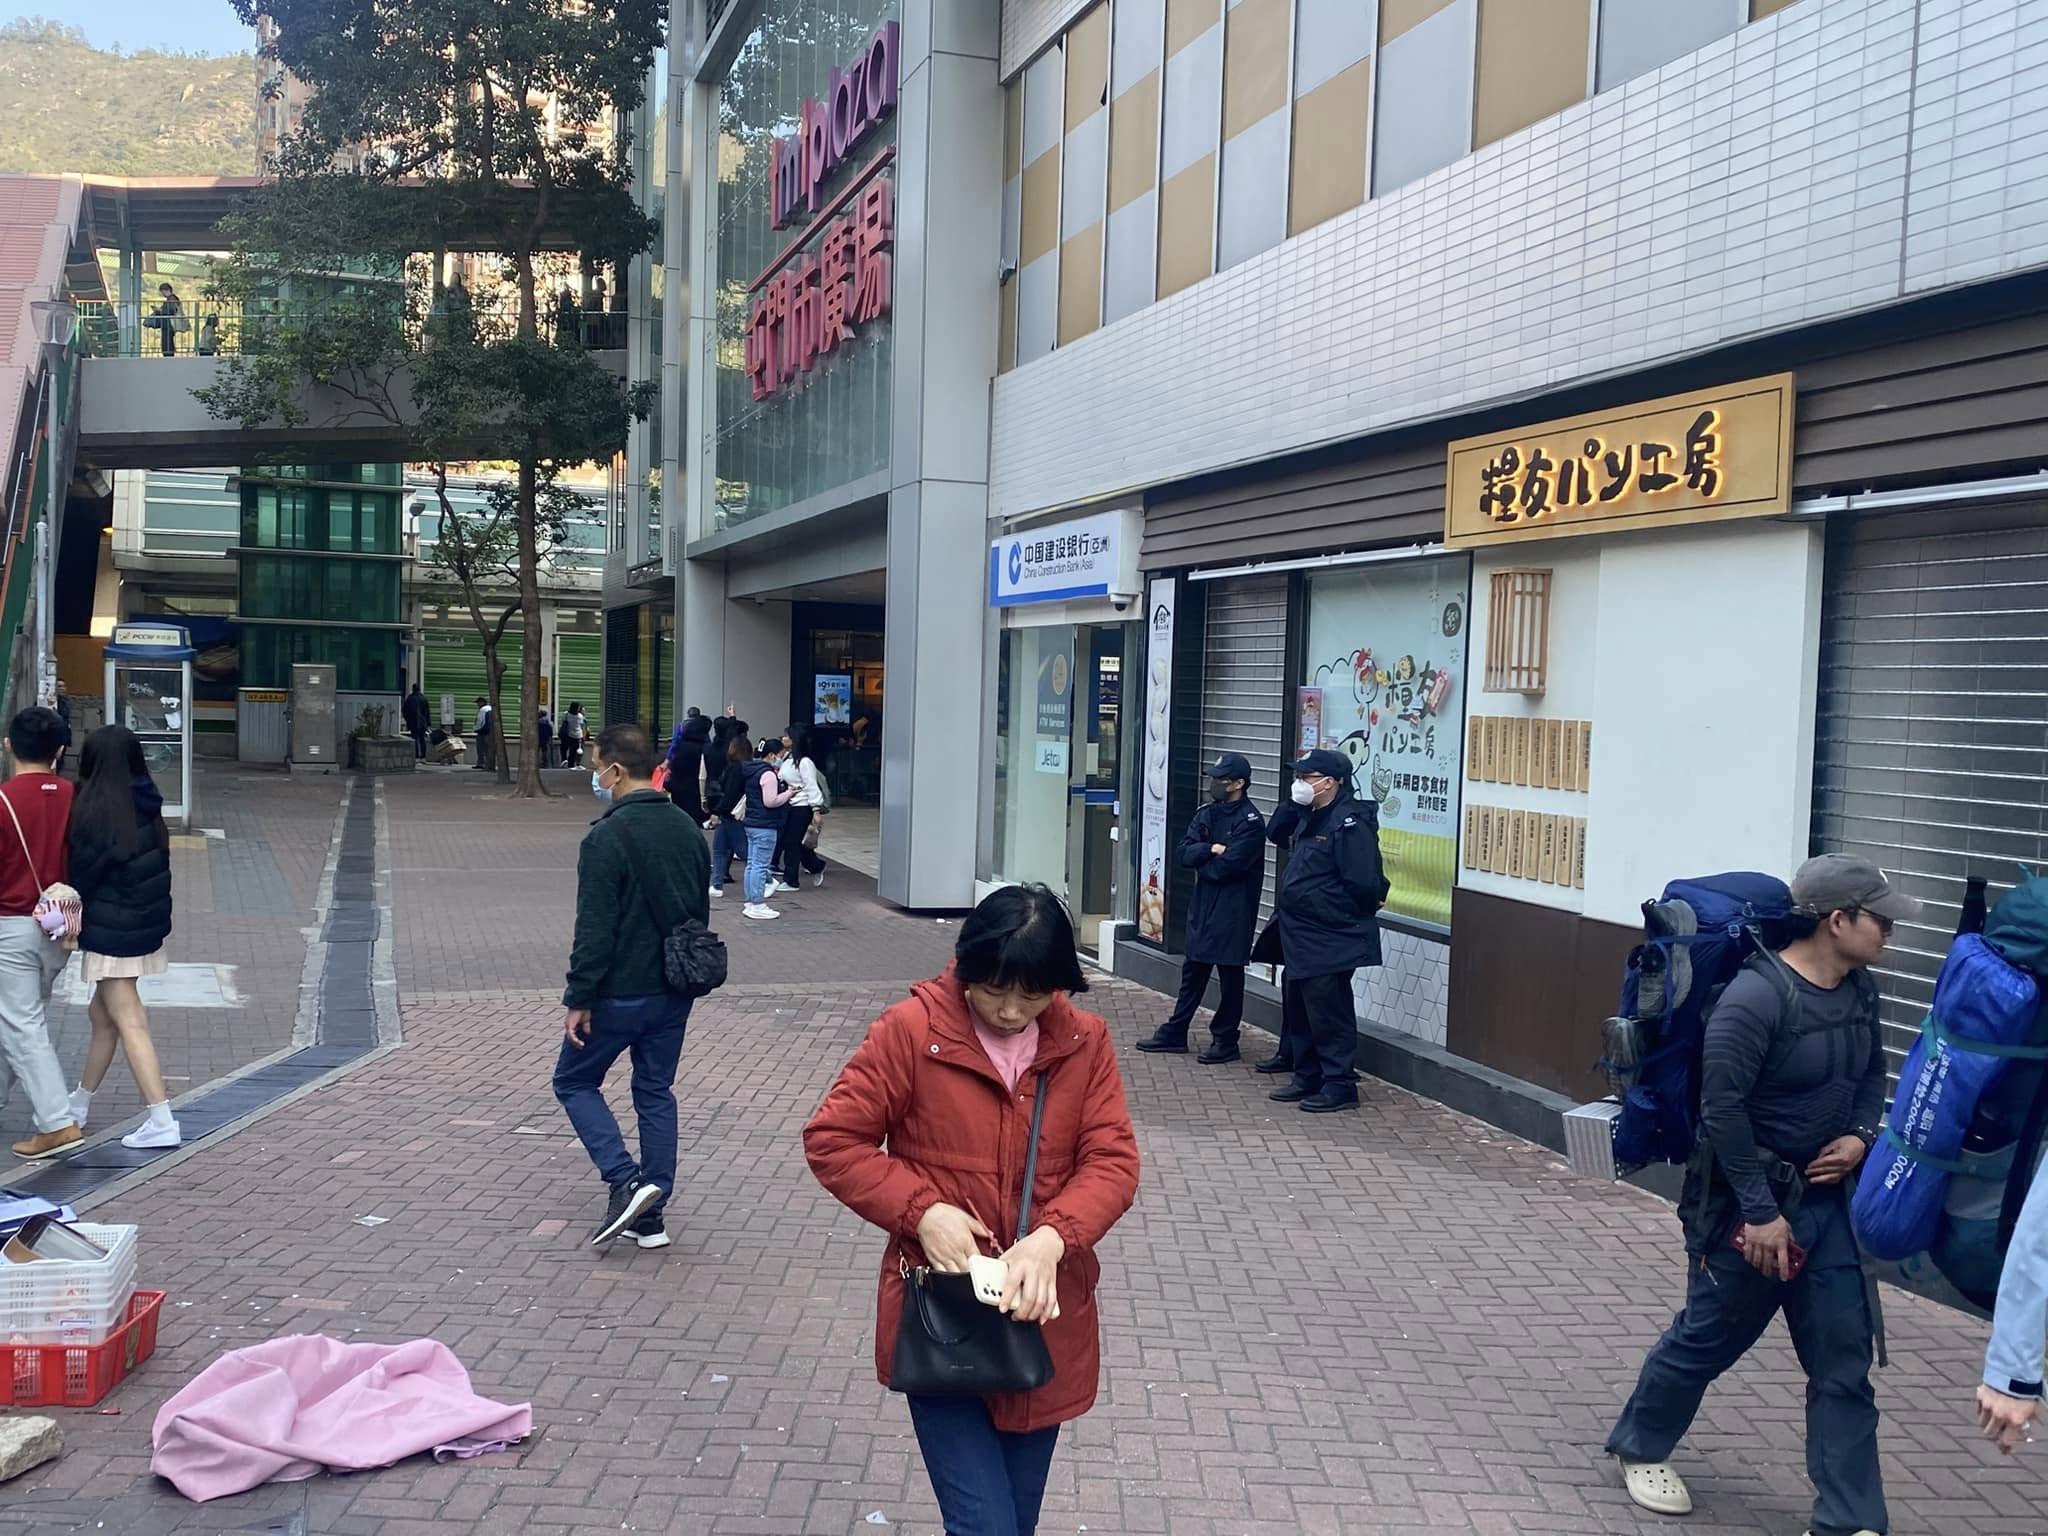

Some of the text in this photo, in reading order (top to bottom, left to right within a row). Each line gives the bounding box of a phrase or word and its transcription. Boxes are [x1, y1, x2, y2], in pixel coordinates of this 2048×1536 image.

[743, 177, 895, 402] 屯門市廣場
